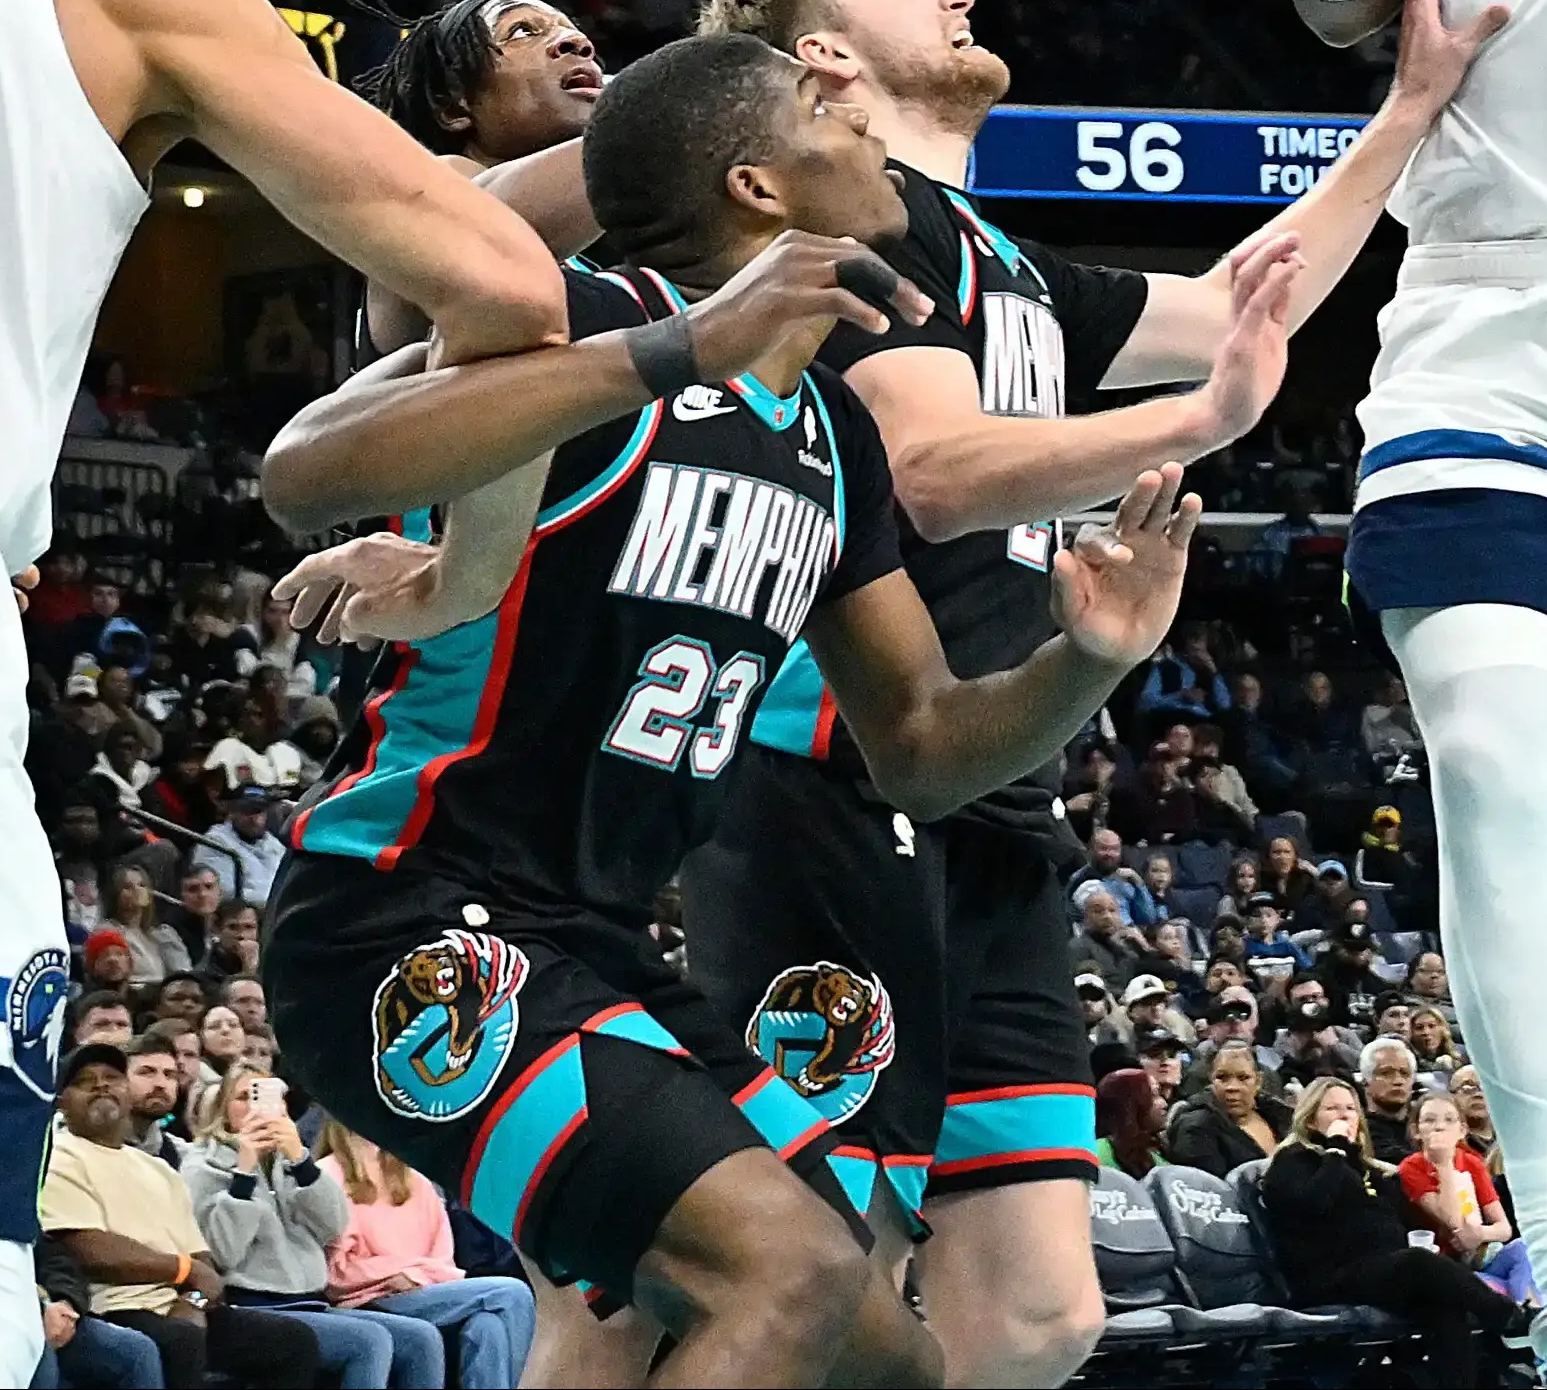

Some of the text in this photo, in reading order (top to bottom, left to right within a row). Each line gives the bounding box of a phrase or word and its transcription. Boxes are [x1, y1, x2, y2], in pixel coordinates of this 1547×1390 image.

[1076, 121, 1184, 193] 56
[1257, 126, 1361, 158] TIMEO
[601, 634, 766, 779] 23
[12, 951, 59, 1032] MINNESOTA
